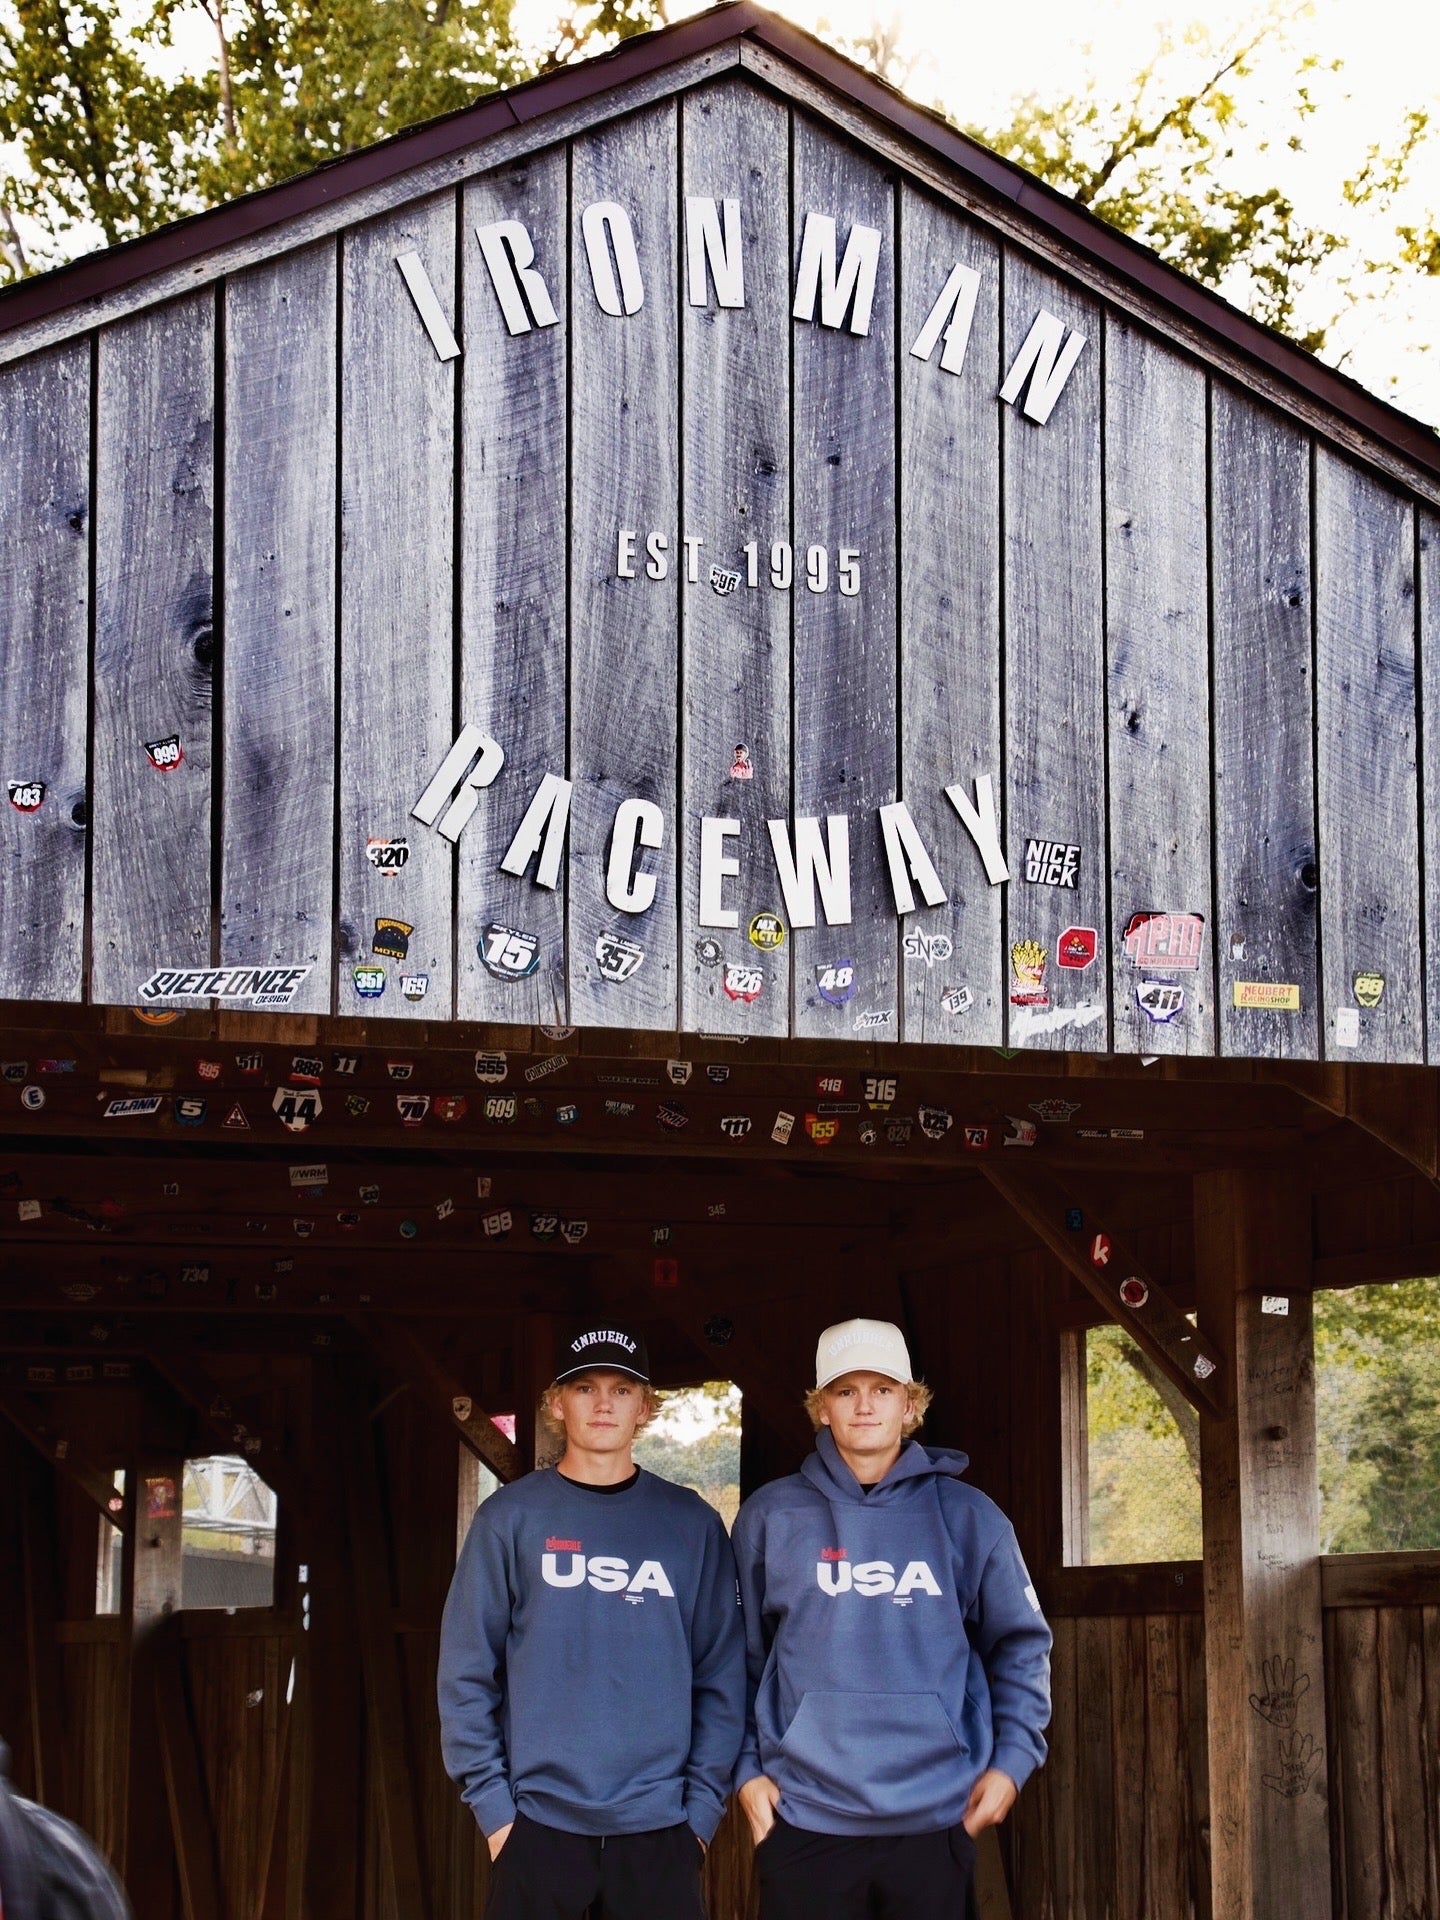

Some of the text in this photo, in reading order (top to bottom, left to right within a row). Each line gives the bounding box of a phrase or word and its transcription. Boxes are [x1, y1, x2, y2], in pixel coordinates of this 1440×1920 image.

[396, 196, 1088, 426] IRONMAN
[617, 531, 861, 596] EST 1995
[153, 744, 179, 766] 999
[12, 788, 41, 806] 483
[410, 722, 1010, 928] RACEWAY
[370, 847, 409, 867] 320
[1026, 840, 1081, 866] NICE
[1026, 860, 1079, 888] DICK
[491, 924, 538, 943] SKYLER
[756, 918, 777, 931] MX
[751, 930, 783, 944] ACTU
[374, 946, 405, 958] MOTO
[485, 932, 537, 971] 15
[600, 943, 641, 976] 357
[356, 972, 384, 989] 351
[401, 977, 427, 995] 169
[726, 969, 763, 993] 826
[818, 967, 854, 991] 48
[255, 994, 291, 1005] DESIGN
[949, 991, 968, 1010] 139
[1141, 987, 1183, 1011] 411
[1244, 986, 1293, 998] NEUBERT
[335, 1057, 358, 1075] 11
[477, 1060, 506, 1075] 555
[864, 1078, 897, 1101] 316
[179, 1100, 204, 1118] 5
[276, 1096, 317, 1125] 44
[486, 1098, 515, 1119] 609
[811, 1121, 836, 1138] 155
[482, 1211, 513, 1236] 198
[532, 1217, 558, 1233] 32
[570, 1330, 637, 1354] UNRUEHLE
[541, 1553, 675, 1598] USA
[816, 1560, 943, 1597] USA
